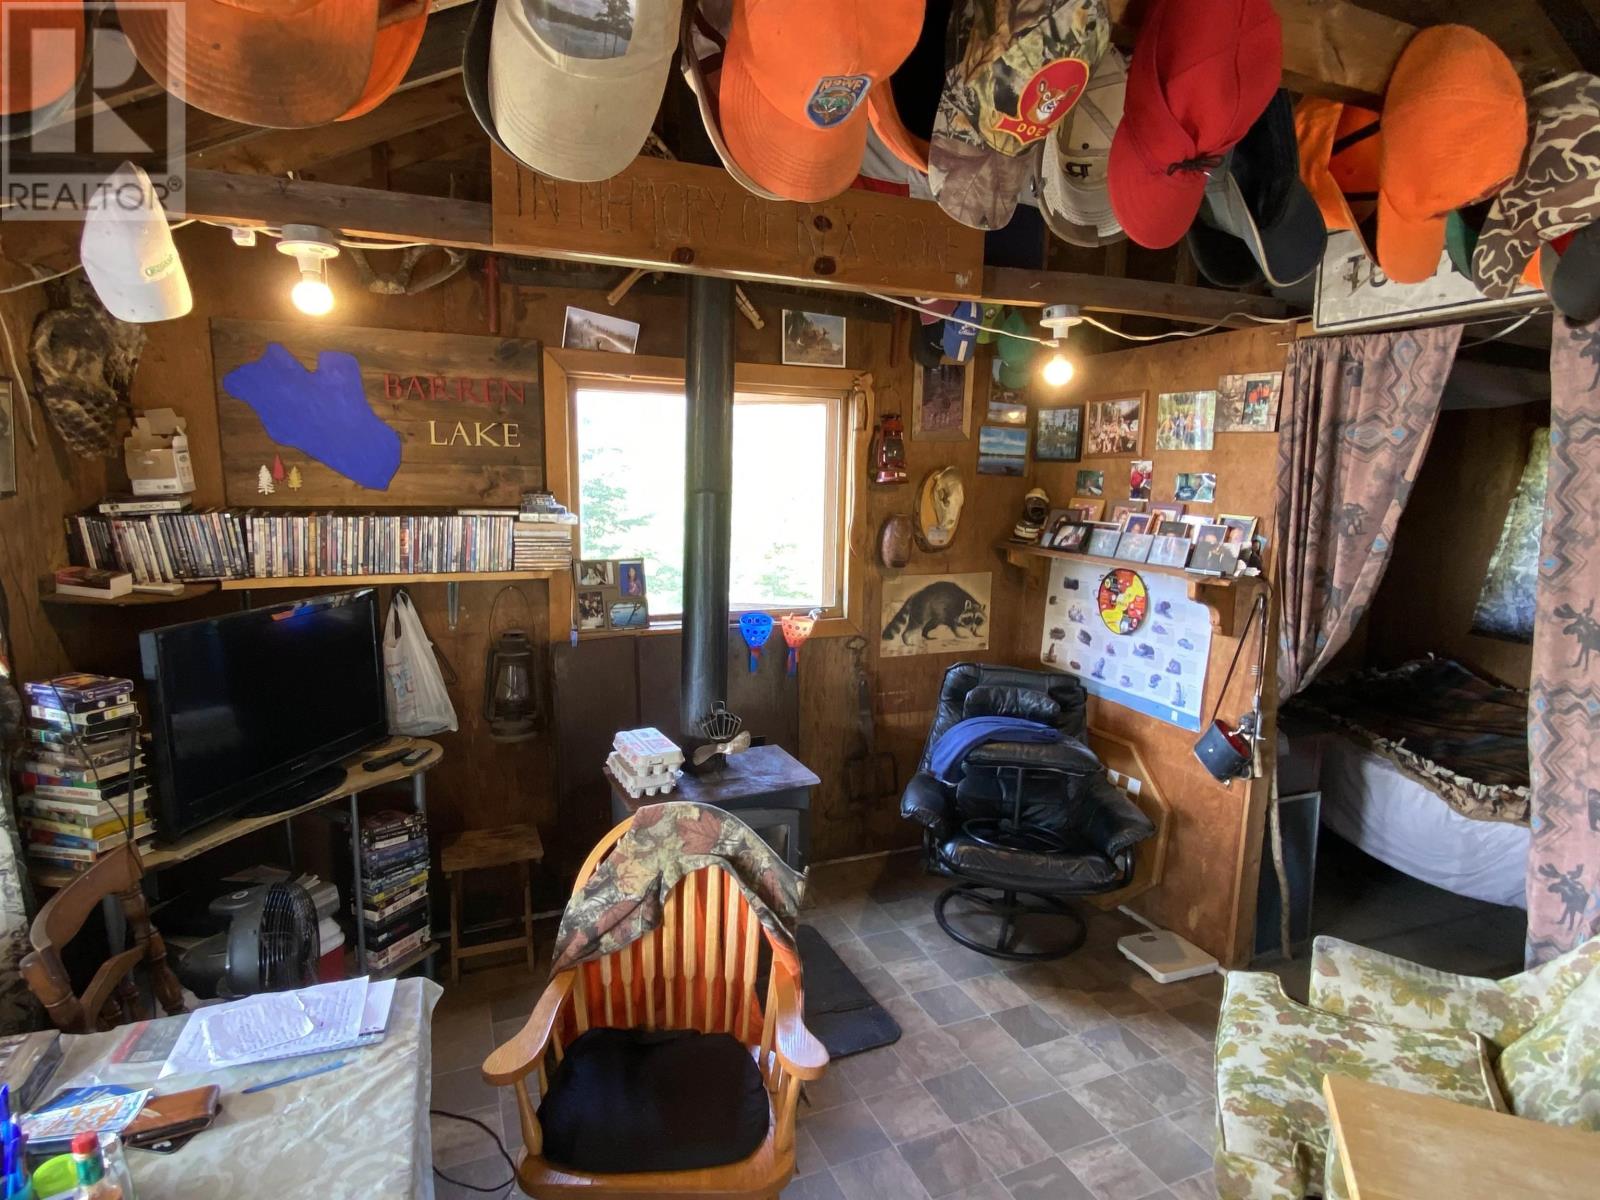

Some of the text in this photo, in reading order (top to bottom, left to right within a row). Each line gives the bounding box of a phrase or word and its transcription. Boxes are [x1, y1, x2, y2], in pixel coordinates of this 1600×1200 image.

[1016, 123, 1045, 137] DOE
[515, 163, 560, 225] IN
[578, 175, 728, 248] MEMORY
[741, 193, 784, 250] OF
[383, 372, 527, 406] BARREN
[427, 420, 522, 448] LAKE
